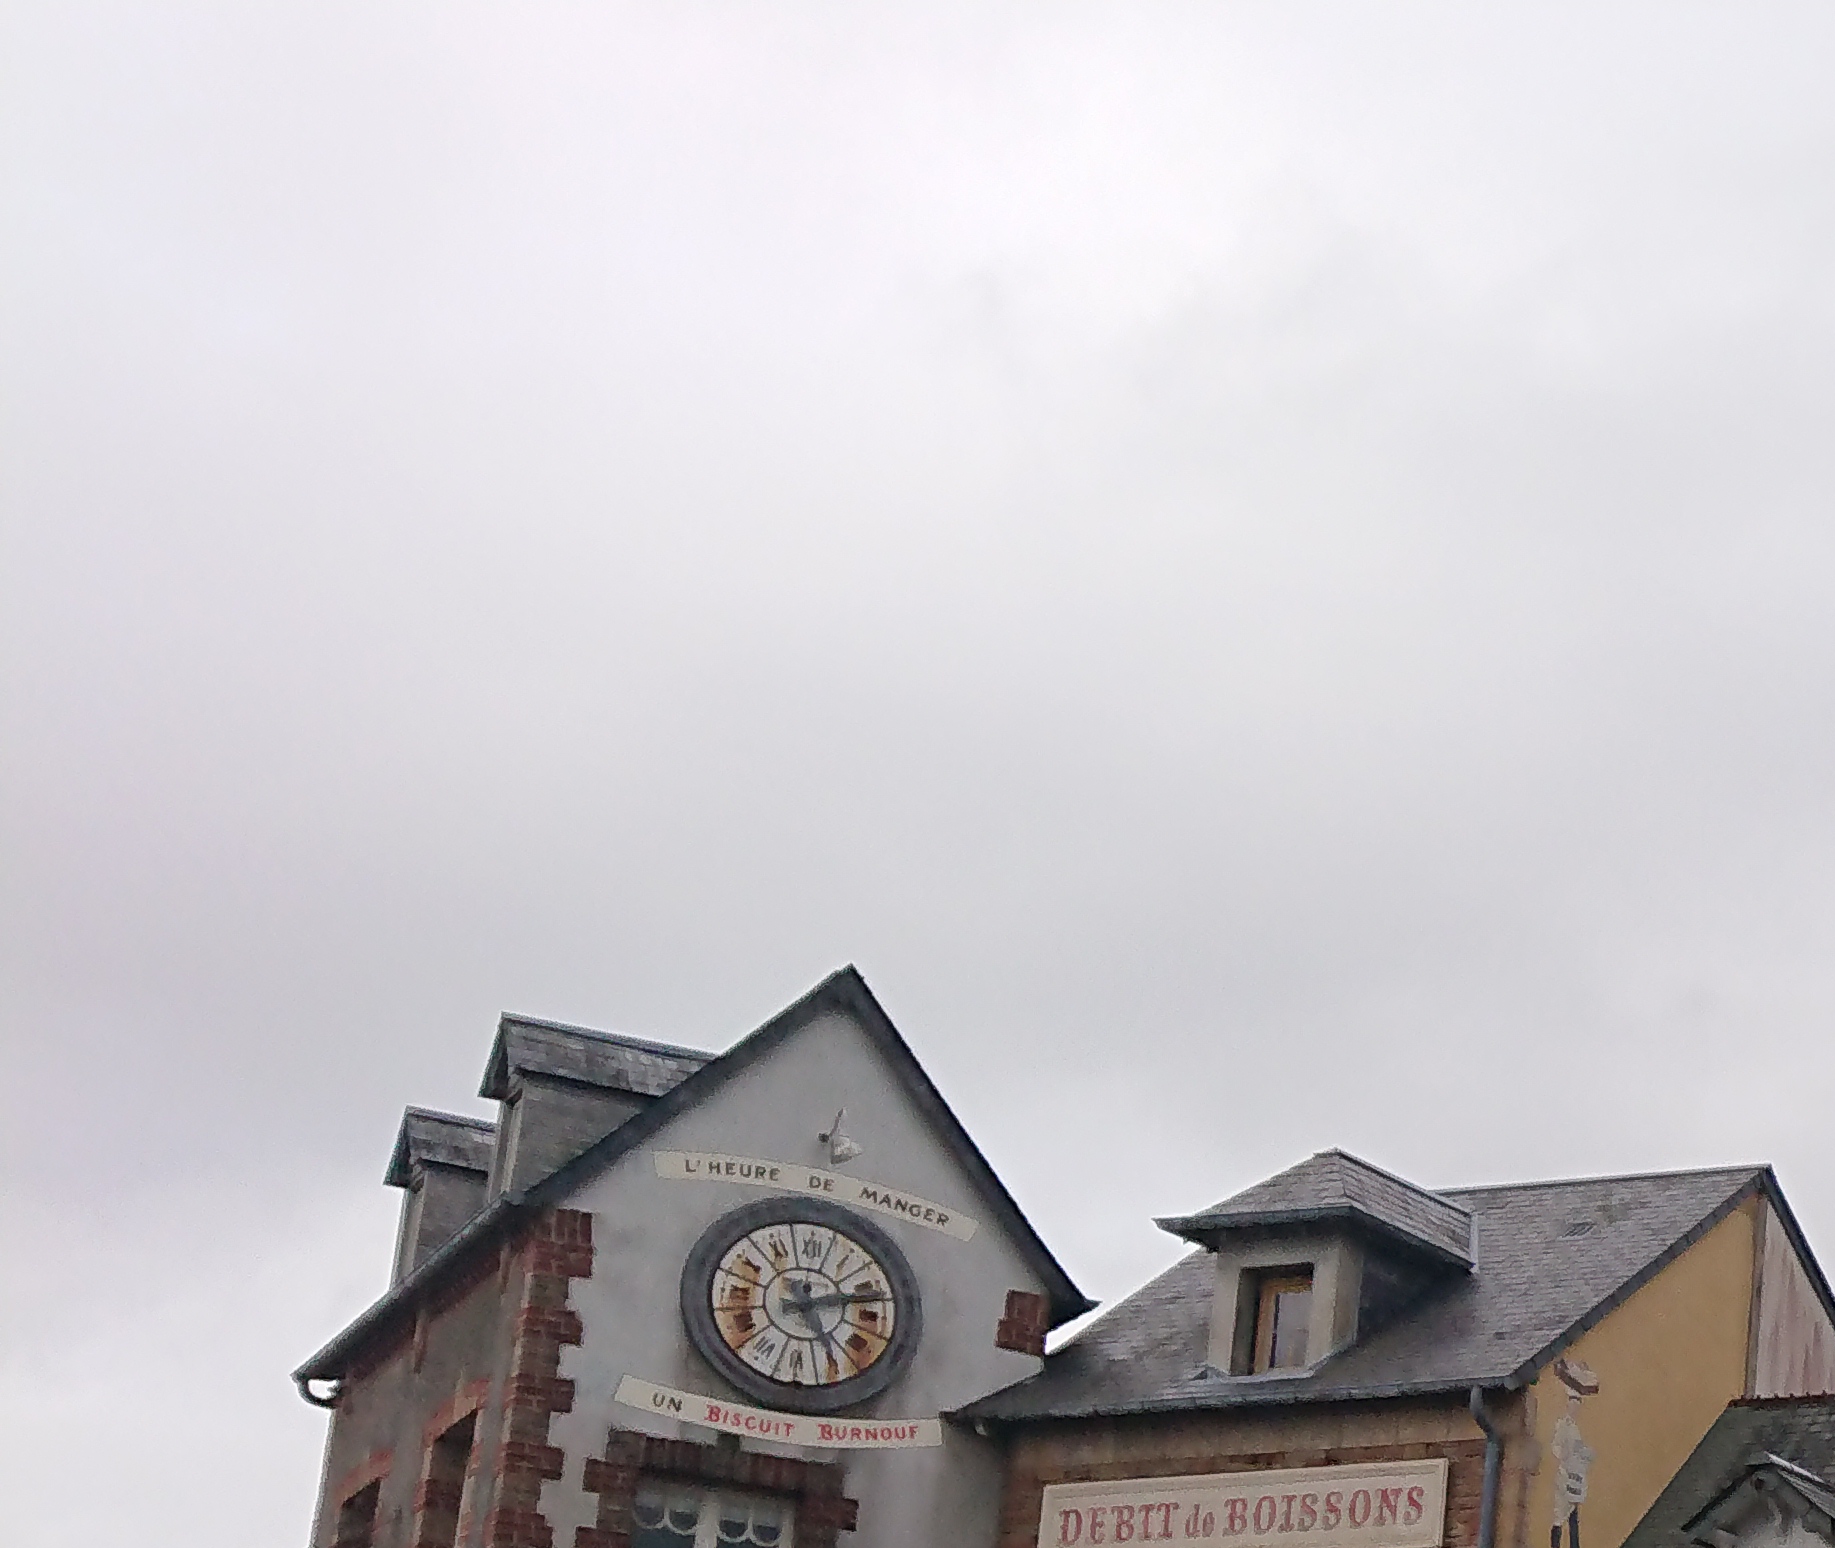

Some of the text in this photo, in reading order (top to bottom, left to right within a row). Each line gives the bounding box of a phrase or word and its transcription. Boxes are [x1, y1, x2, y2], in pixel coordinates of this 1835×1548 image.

[684, 1159, 951, 1228] L'HEURE DE MANGER
[652, 1392, 919, 1443] UN BISCUIT BURNOUF
[1056, 1485, 1426, 1548] DEBIT de BOISSONS
